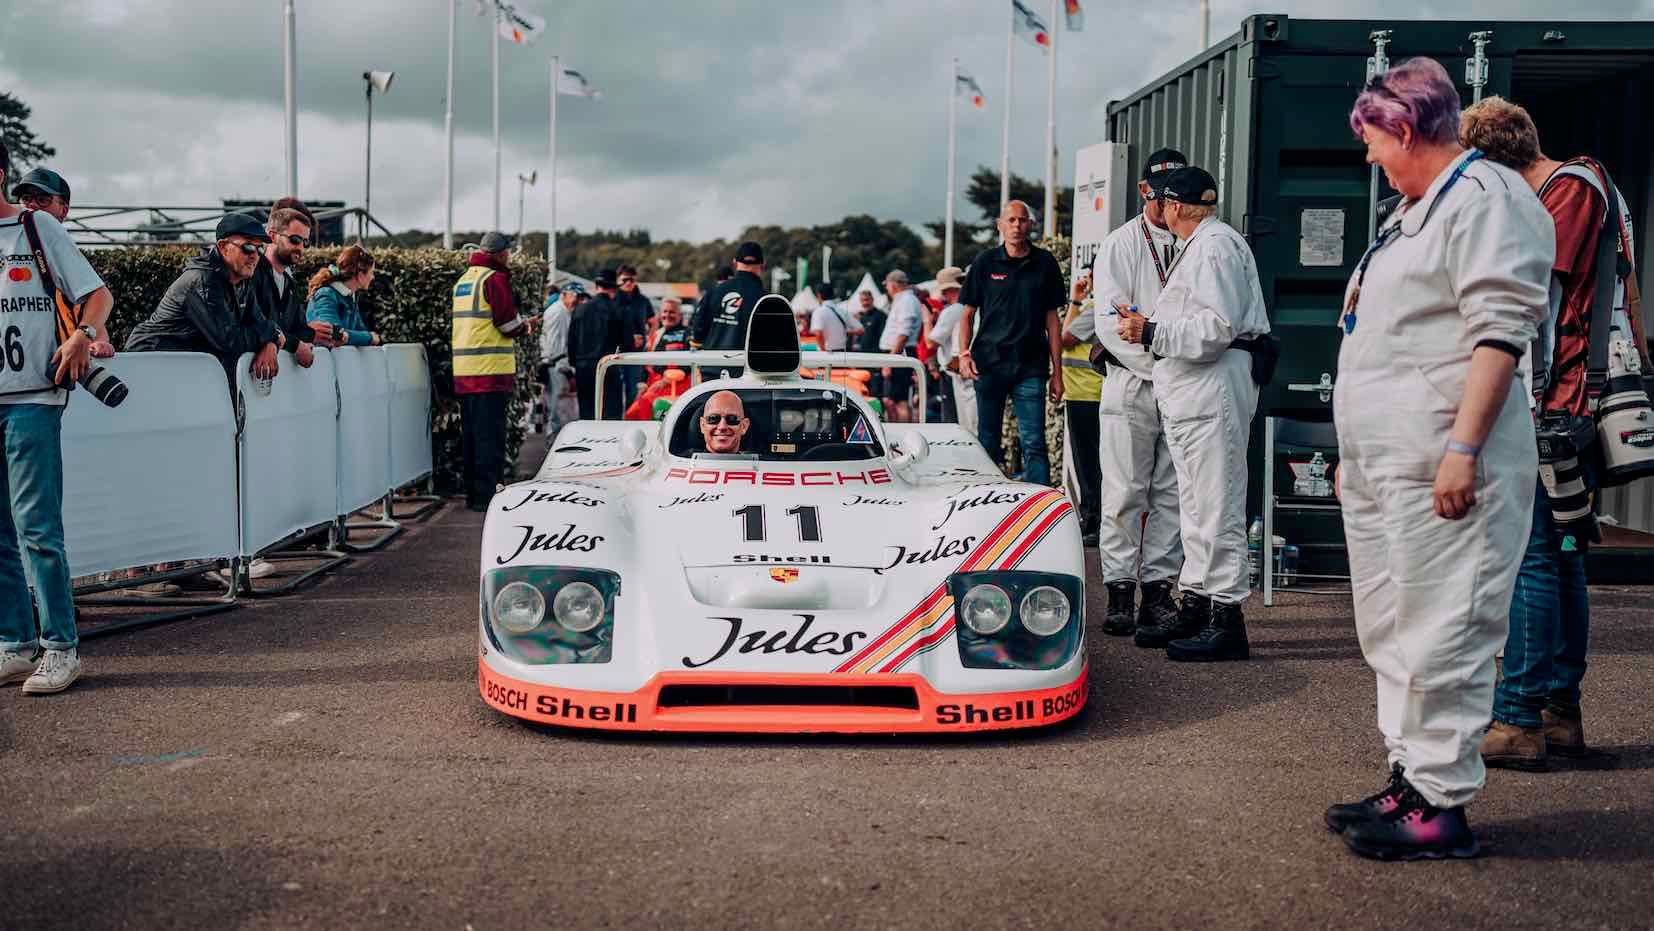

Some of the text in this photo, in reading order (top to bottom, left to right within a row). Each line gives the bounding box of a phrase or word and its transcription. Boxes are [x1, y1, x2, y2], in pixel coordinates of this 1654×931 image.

[1, 296, 52, 312] RAPHER
[665, 468, 893, 487] PORSCHE
[502, 489, 606, 512] Jules
[658, 490, 725, 509] Jules
[842, 495, 906, 506] Jules
[932, 490, 1026, 531] Jules
[731, 503, 823, 543] 11
[496, 523, 605, 565] Jules
[873, 535, 976, 575] Jules
[732, 553, 832, 564] Shell
[682, 613, 867, 668] Jules
[487, 680, 637, 723] BOSCH Shell
[936, 700, 1034, 724] Shell
